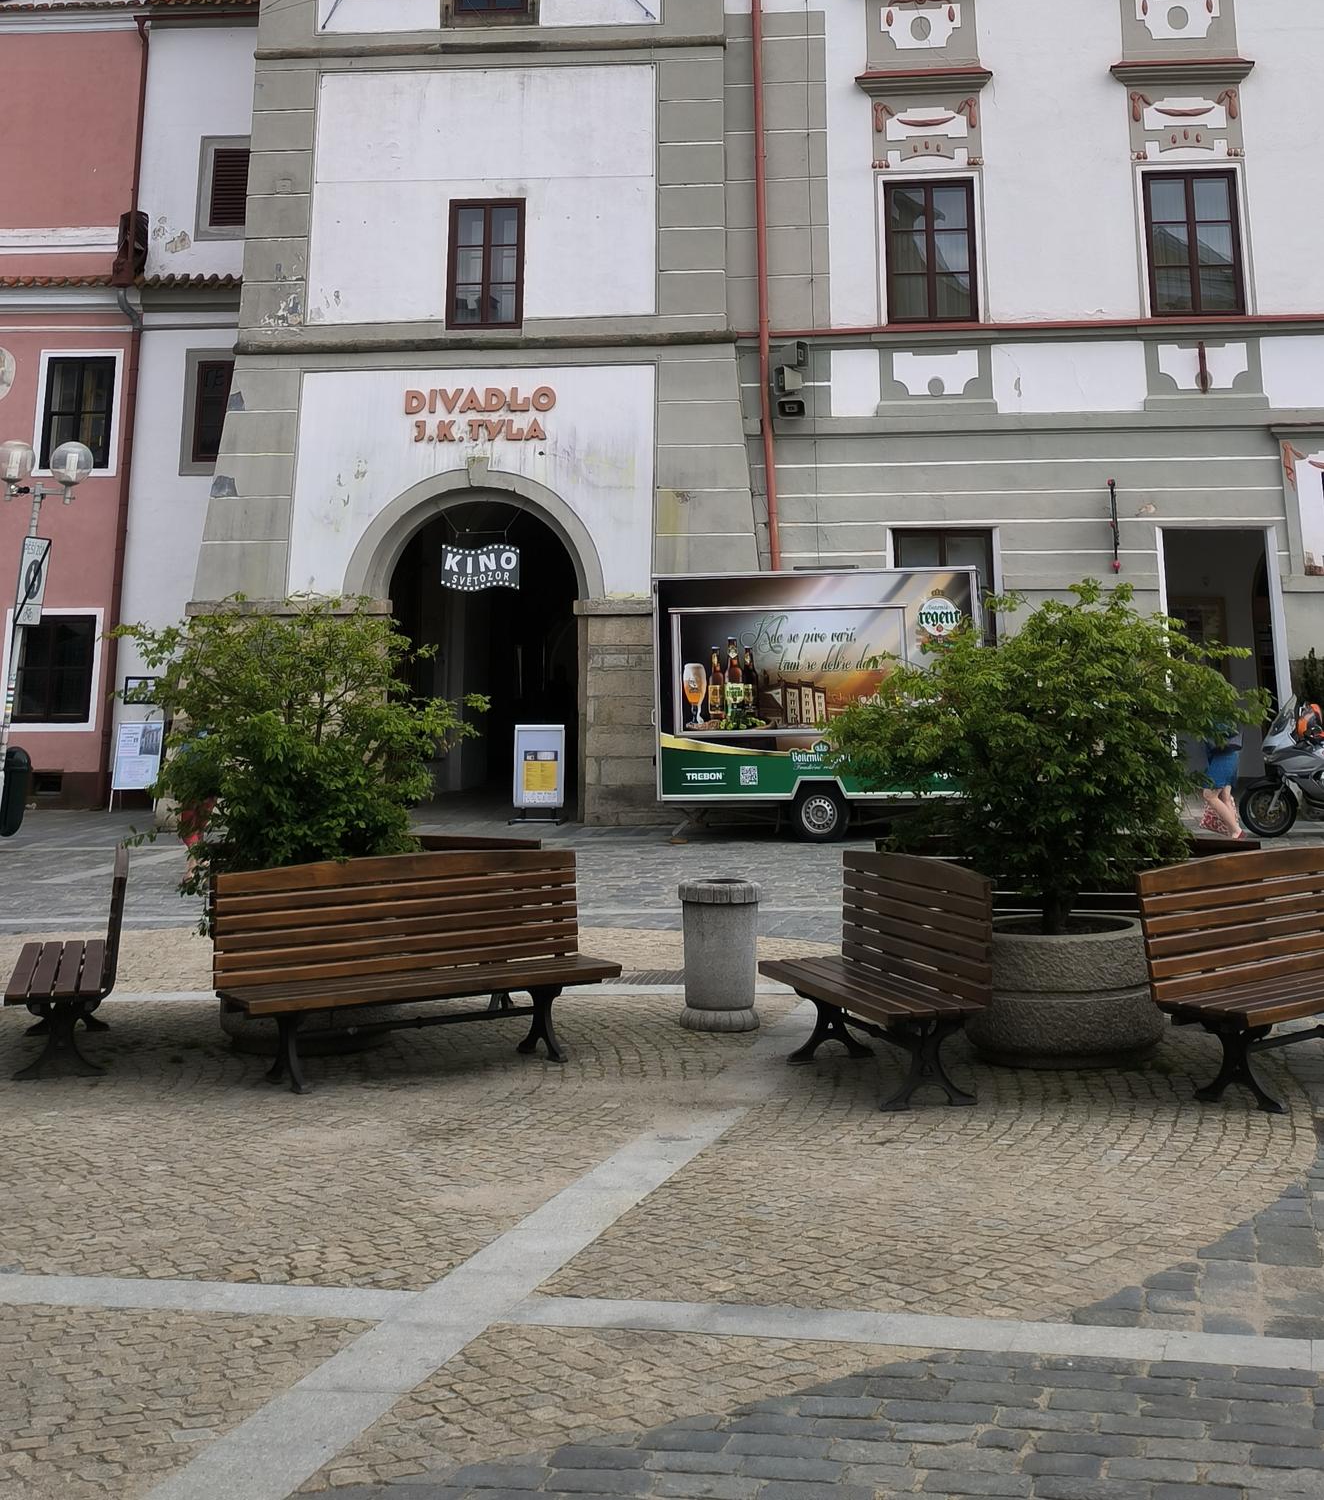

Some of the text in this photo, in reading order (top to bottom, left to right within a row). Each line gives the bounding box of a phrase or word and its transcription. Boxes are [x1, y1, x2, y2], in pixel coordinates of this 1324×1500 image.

[405, 386, 557, 415] DIVADLO
[444, 551, 517, 574] KINO
[451, 571, 510, 586] SVĚTOZOR
[919, 610, 961, 627] regent
[740, 614, 788, 654] Kde
[787, 633, 799, 643] se
[798, 627, 828, 660] pivo
[778, 648, 801, 671] tam
[807, 660, 817, 670] se
